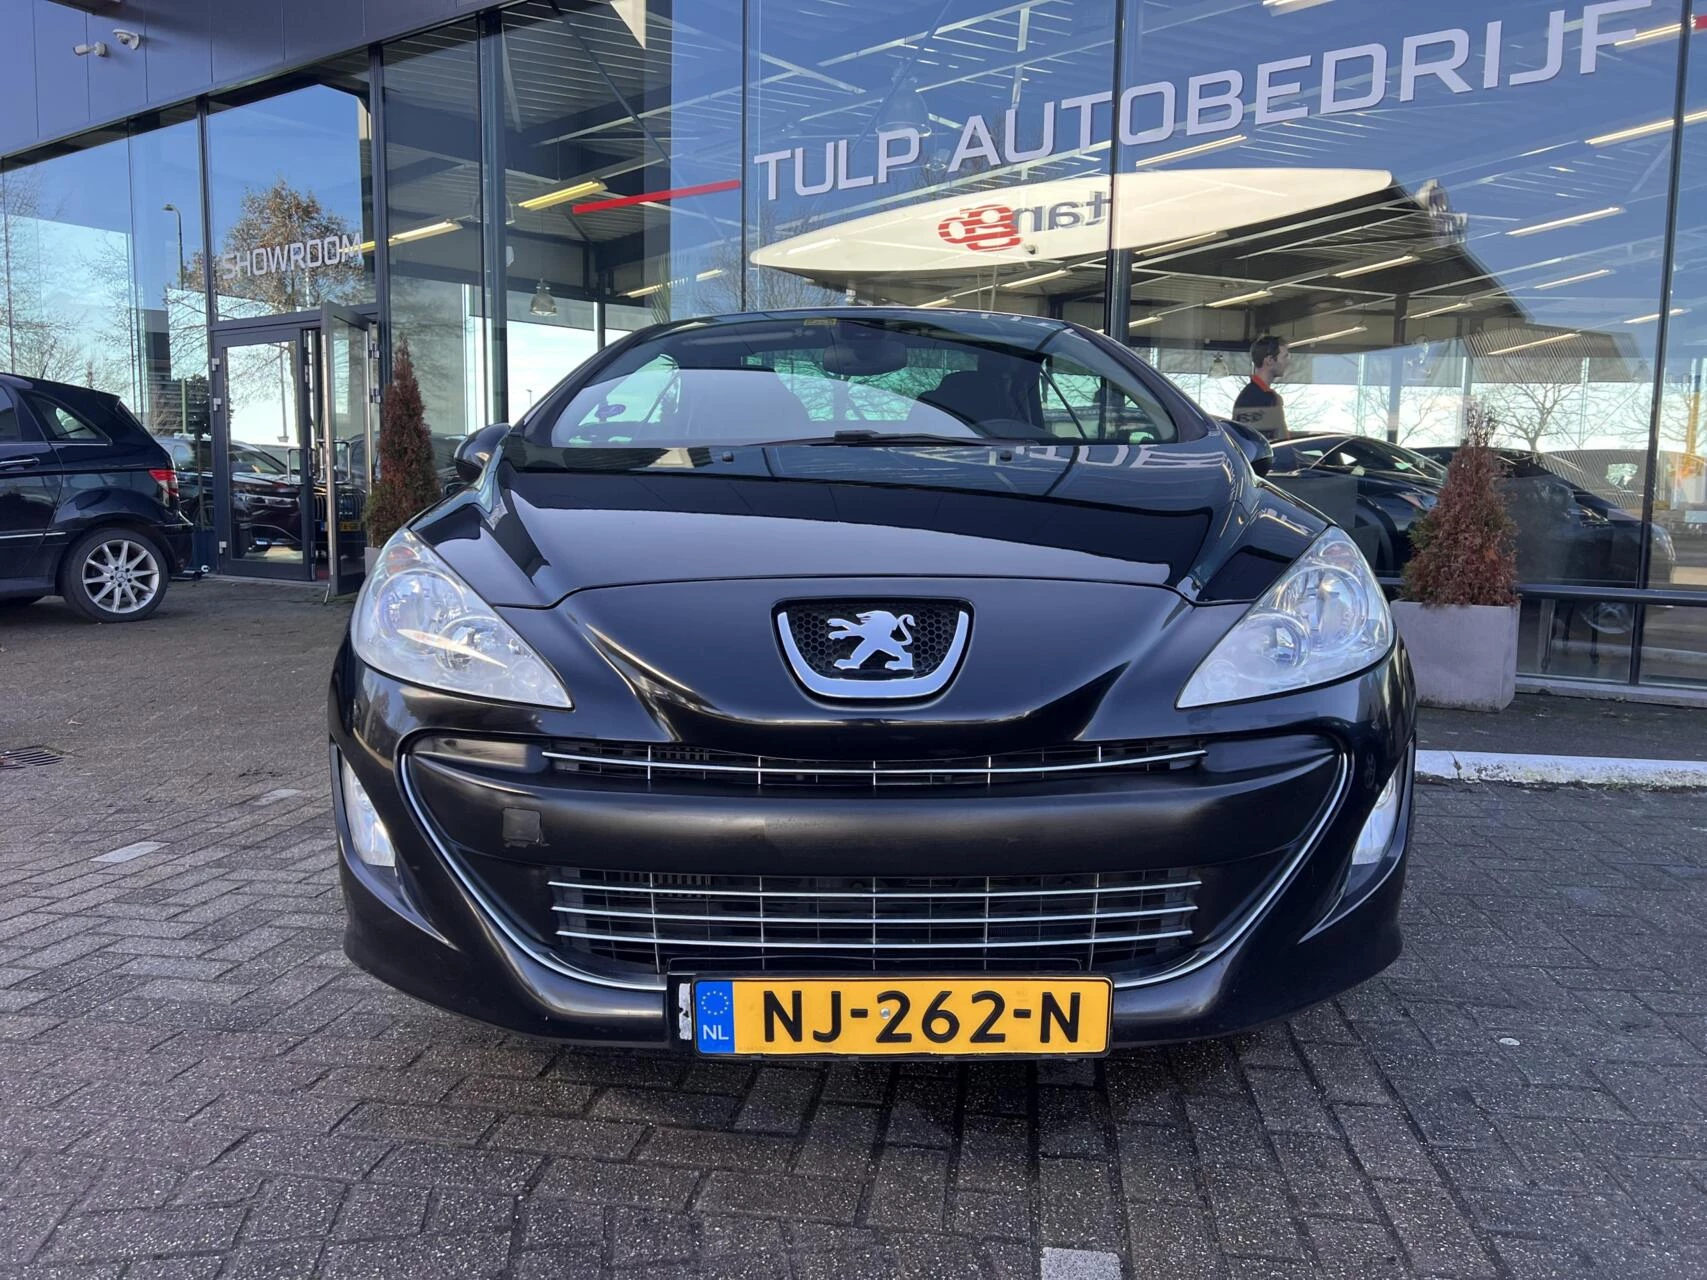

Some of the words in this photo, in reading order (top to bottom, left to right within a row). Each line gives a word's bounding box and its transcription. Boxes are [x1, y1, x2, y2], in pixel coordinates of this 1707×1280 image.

[754, 127, 921, 201] TULP
[948, 0, 1652, 173] AUTOBEDRIJF
[222, 233, 363, 280] SHOWROOM
[702, 1023, 729, 1041] NL
[762, 990, 1081, 1044] NJ-262-N
